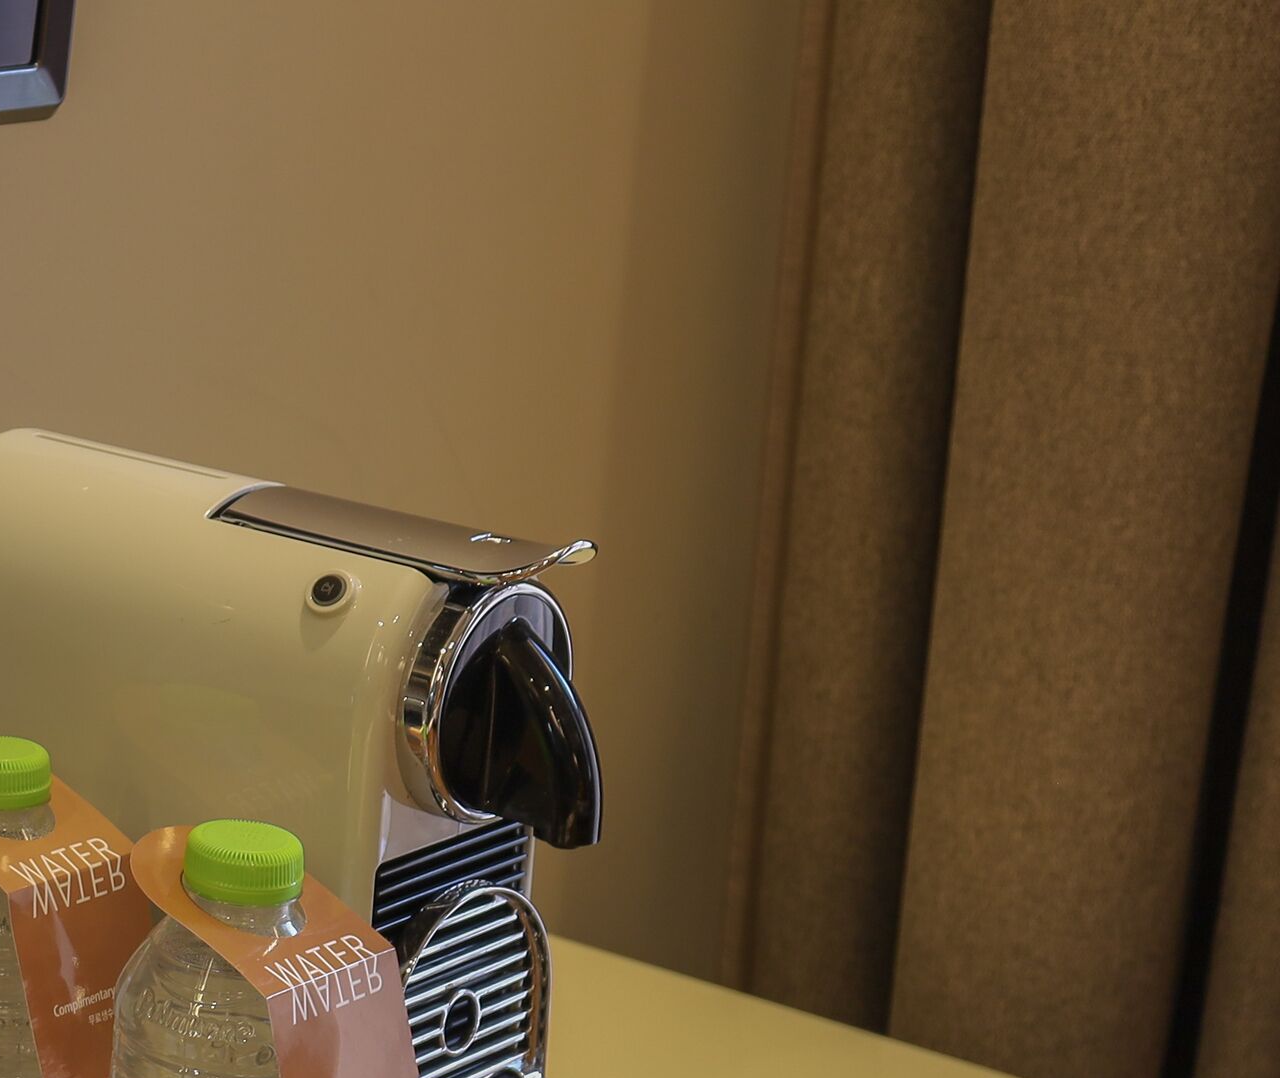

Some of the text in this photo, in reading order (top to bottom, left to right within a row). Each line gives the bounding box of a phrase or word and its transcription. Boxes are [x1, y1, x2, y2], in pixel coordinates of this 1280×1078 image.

[9, 837, 121, 885] WATER
[264, 935, 378, 988] WATER
[53, 986, 115, 1018] Complimentary
